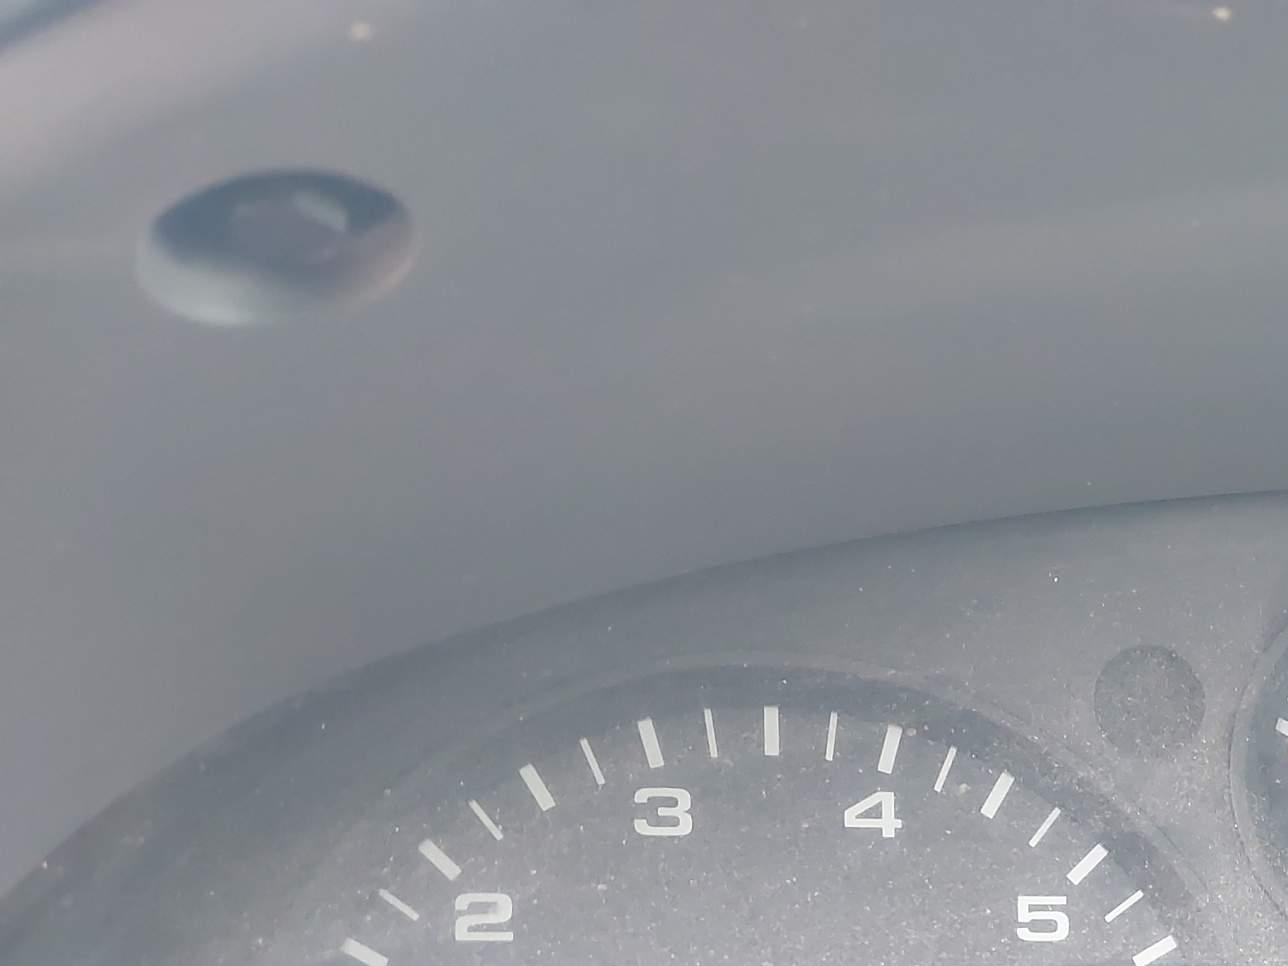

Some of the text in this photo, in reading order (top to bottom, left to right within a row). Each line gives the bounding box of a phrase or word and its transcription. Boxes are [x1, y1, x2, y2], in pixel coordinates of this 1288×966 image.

[633, 787, 693, 837] 3
[843, 791, 903, 839] 4
[454, 892, 514, 942] 2
[1016, 895, 1070, 943] 5
